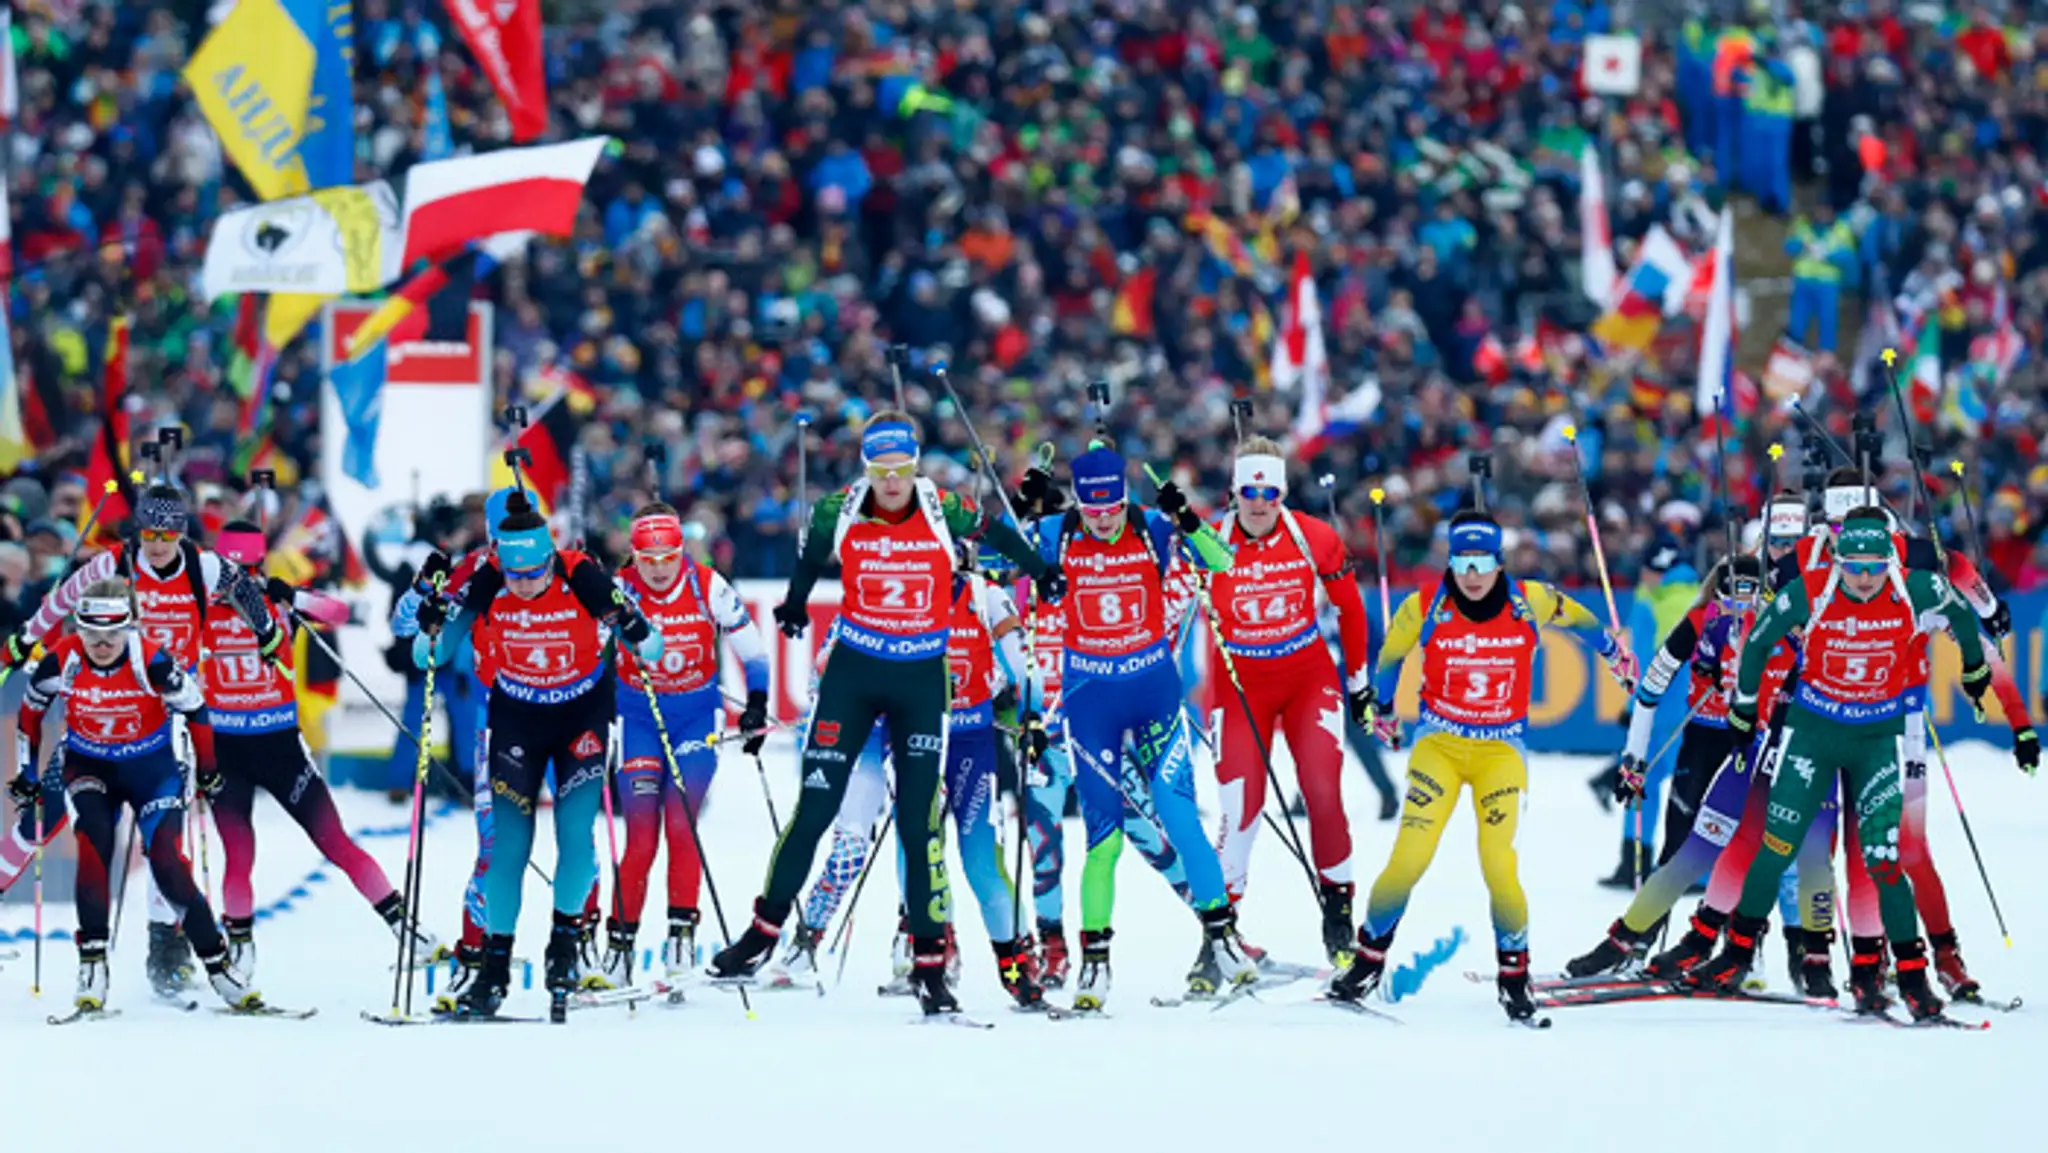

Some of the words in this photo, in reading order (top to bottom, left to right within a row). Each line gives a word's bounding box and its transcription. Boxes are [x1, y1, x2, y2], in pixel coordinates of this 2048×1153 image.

[881, 579, 905, 607] 2
[915, 591, 925, 607] 1
[1098, 593, 1123, 624] 8
[1129, 603, 1139, 619] 1
[1240, 595, 1287, 623] 14
[222, 654, 259, 681] 19
[527, 646, 548, 668] 4
[557, 655, 568, 668] 1
[1843, 657, 1868, 681] 5
[1465, 671, 1488, 699] 3
[1496, 682, 1506, 697] 1
[96, 717, 116, 736] 7
[927, 836, 951, 924] GER
